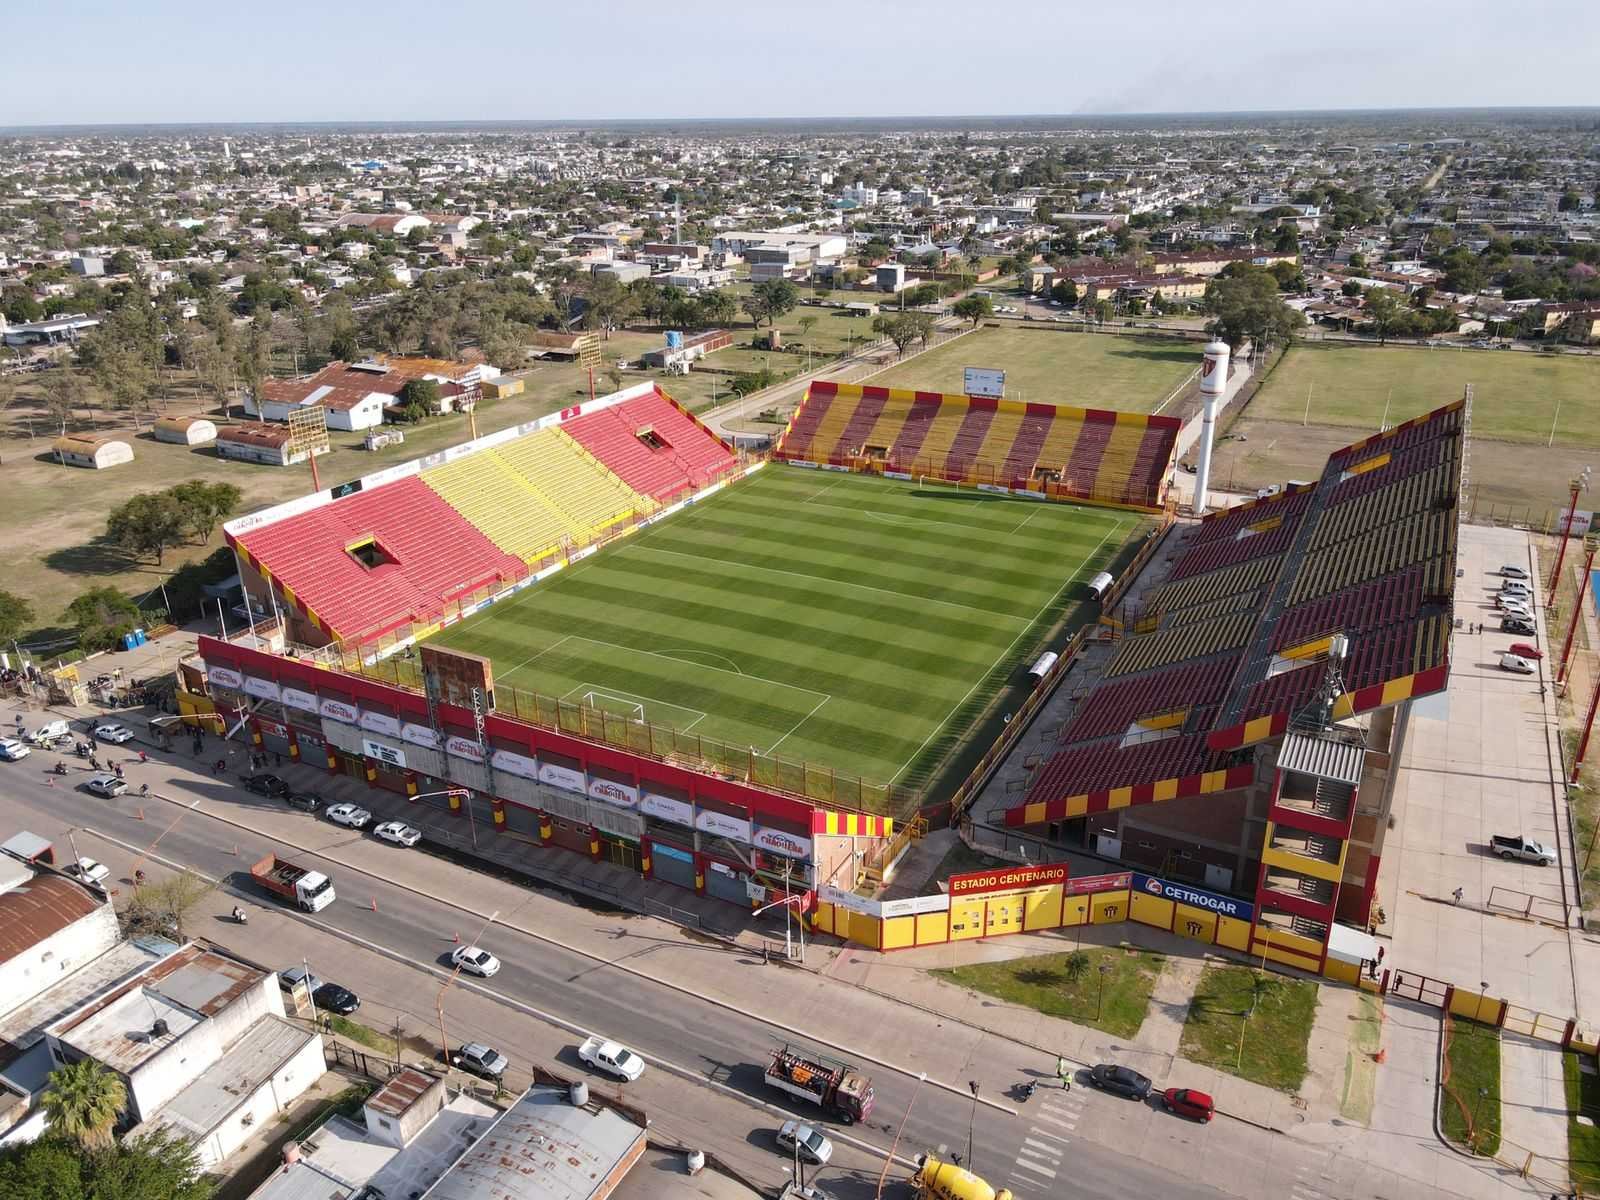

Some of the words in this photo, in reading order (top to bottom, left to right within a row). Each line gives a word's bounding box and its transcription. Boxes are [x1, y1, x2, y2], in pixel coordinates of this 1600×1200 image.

[953, 876, 997, 891] ESTADIO
[1000, 868, 1064, 885] CENTENARIO
[1165, 886, 1237, 914] CETROGAR
